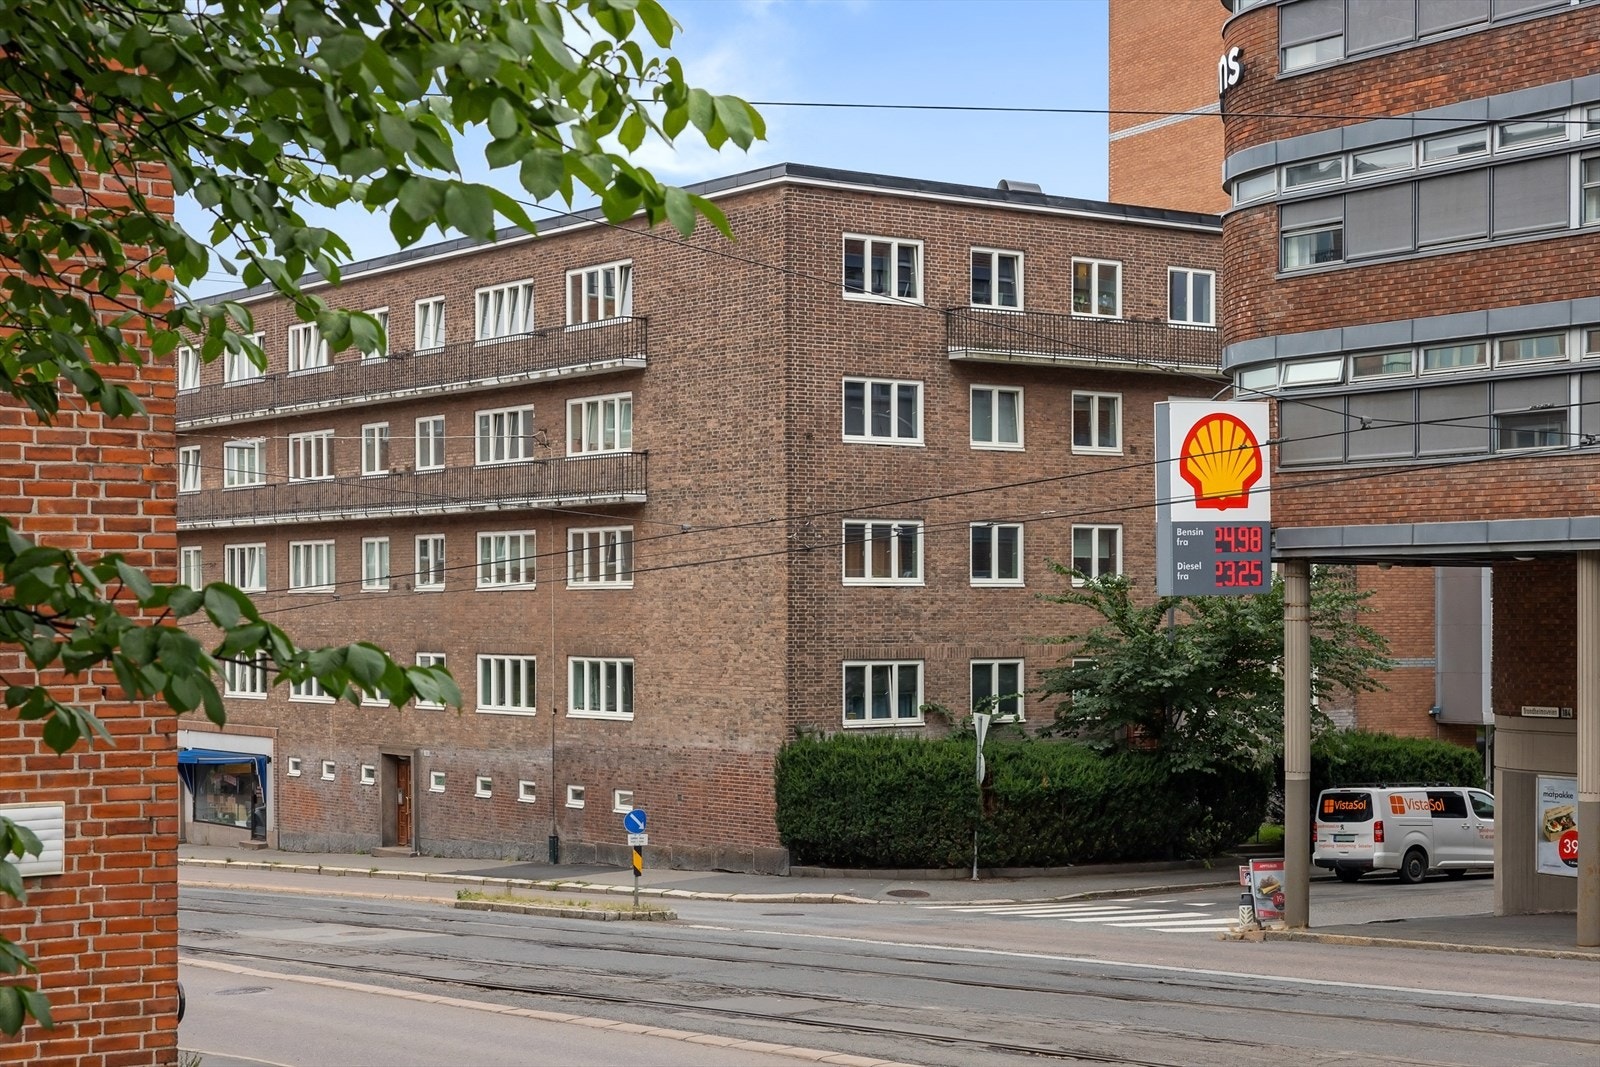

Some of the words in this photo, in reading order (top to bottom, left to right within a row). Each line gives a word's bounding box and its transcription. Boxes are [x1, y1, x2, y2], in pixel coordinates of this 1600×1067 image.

[1176, 527, 1204, 536] Bensin
[1176, 537, 1189, 546] fra
[1177, 561, 1202, 570] Diesel
[1177, 571, 1189, 580] fra
[1543, 791, 1574, 800] matpakke
[1335, 799, 1367, 810] VistaSol
[1404, 797, 1445, 811] VistaSol
[1563, 839, 1578, 854] 39
